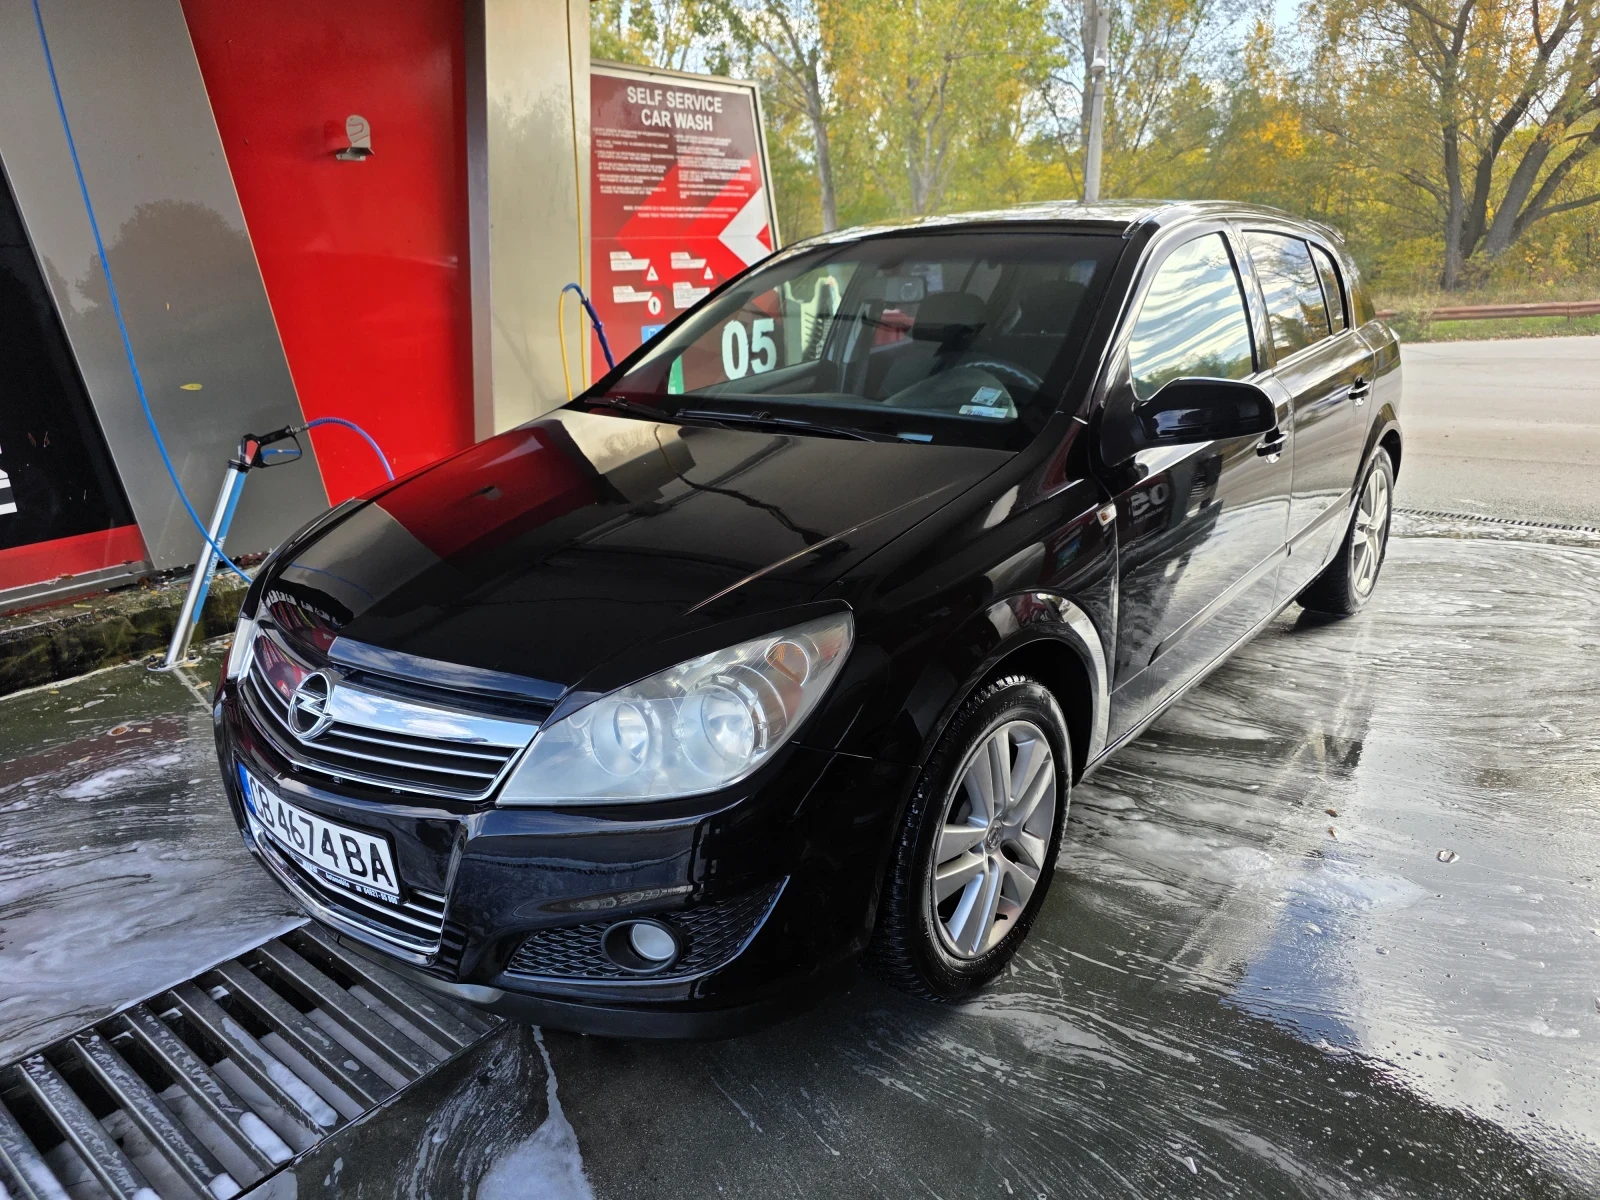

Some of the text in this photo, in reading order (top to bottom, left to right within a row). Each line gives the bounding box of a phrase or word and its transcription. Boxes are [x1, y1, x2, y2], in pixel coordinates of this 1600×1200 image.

[627, 86, 723, 114] SELF SERVICE
[641, 108, 713, 132] CAR WASH
[721, 318, 777, 381] 05
